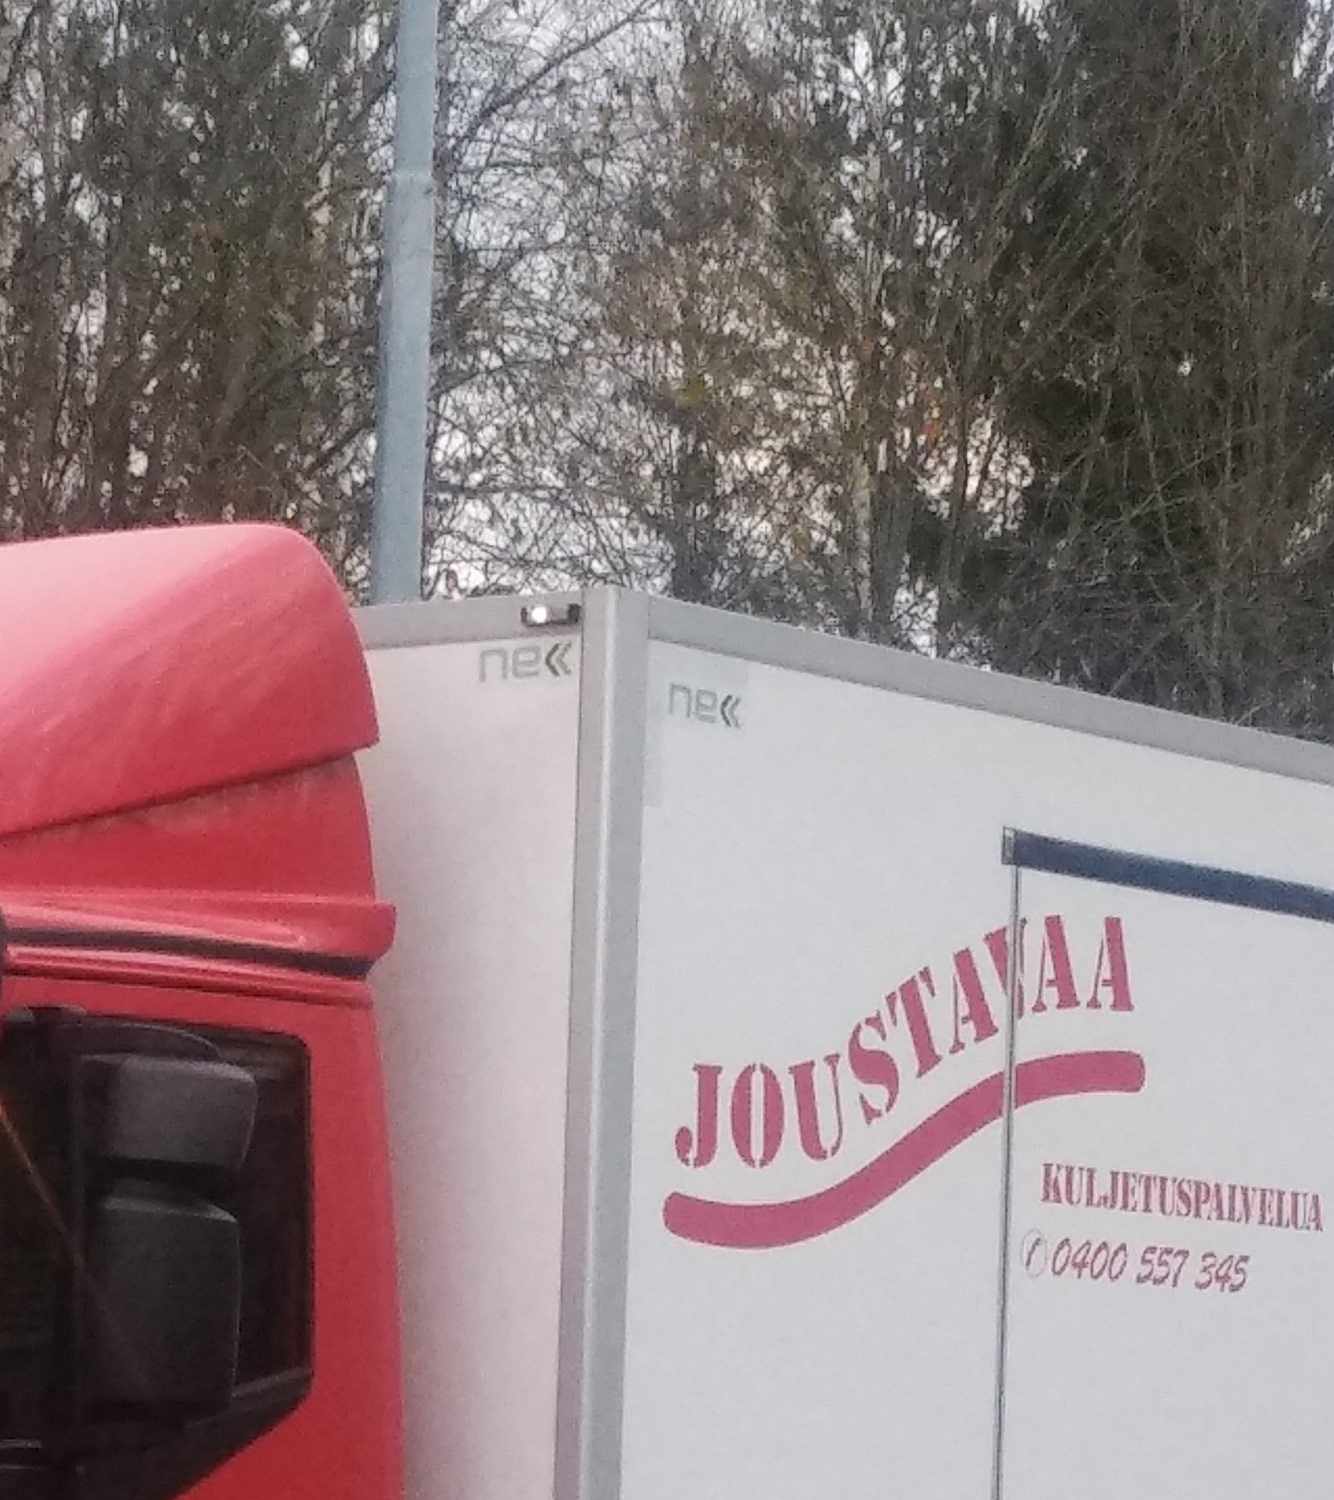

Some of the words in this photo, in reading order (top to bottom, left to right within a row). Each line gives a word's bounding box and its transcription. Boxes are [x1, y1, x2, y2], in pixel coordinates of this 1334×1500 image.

[674, 914, 1135, 1169] JOUSTAVAA
[1040, 1161, 1325, 1233] KULJETUSPALVELUA
[1050, 1237, 1128, 1281] 0400
[1135, 1245, 1190, 1288] 557
[1194, 1251, 1250, 1293] 345
